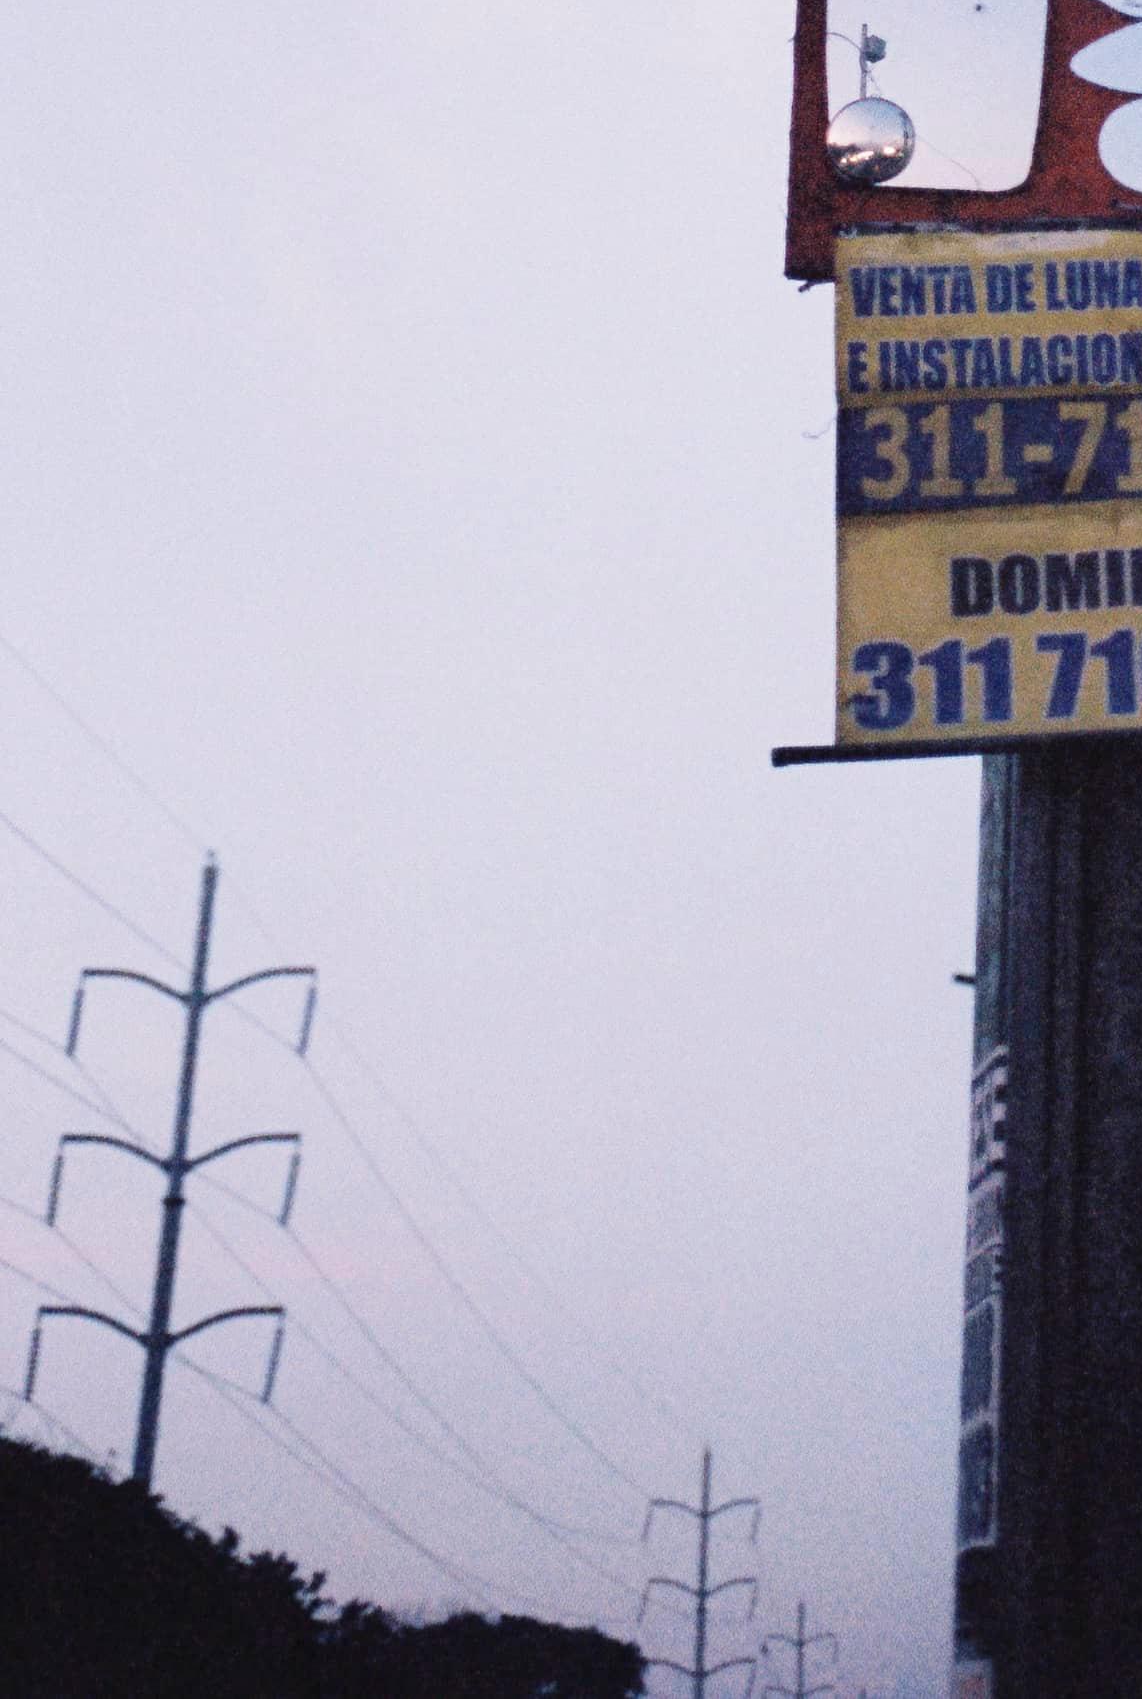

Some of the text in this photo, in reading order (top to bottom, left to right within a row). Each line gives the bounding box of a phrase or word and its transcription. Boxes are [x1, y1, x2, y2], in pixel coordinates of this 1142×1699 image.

[850, 264, 978, 317] VENTA
[985, 262, 1037, 313] DE
[847, 341, 870, 393] E
[849, 635, 1013, 731] 311
